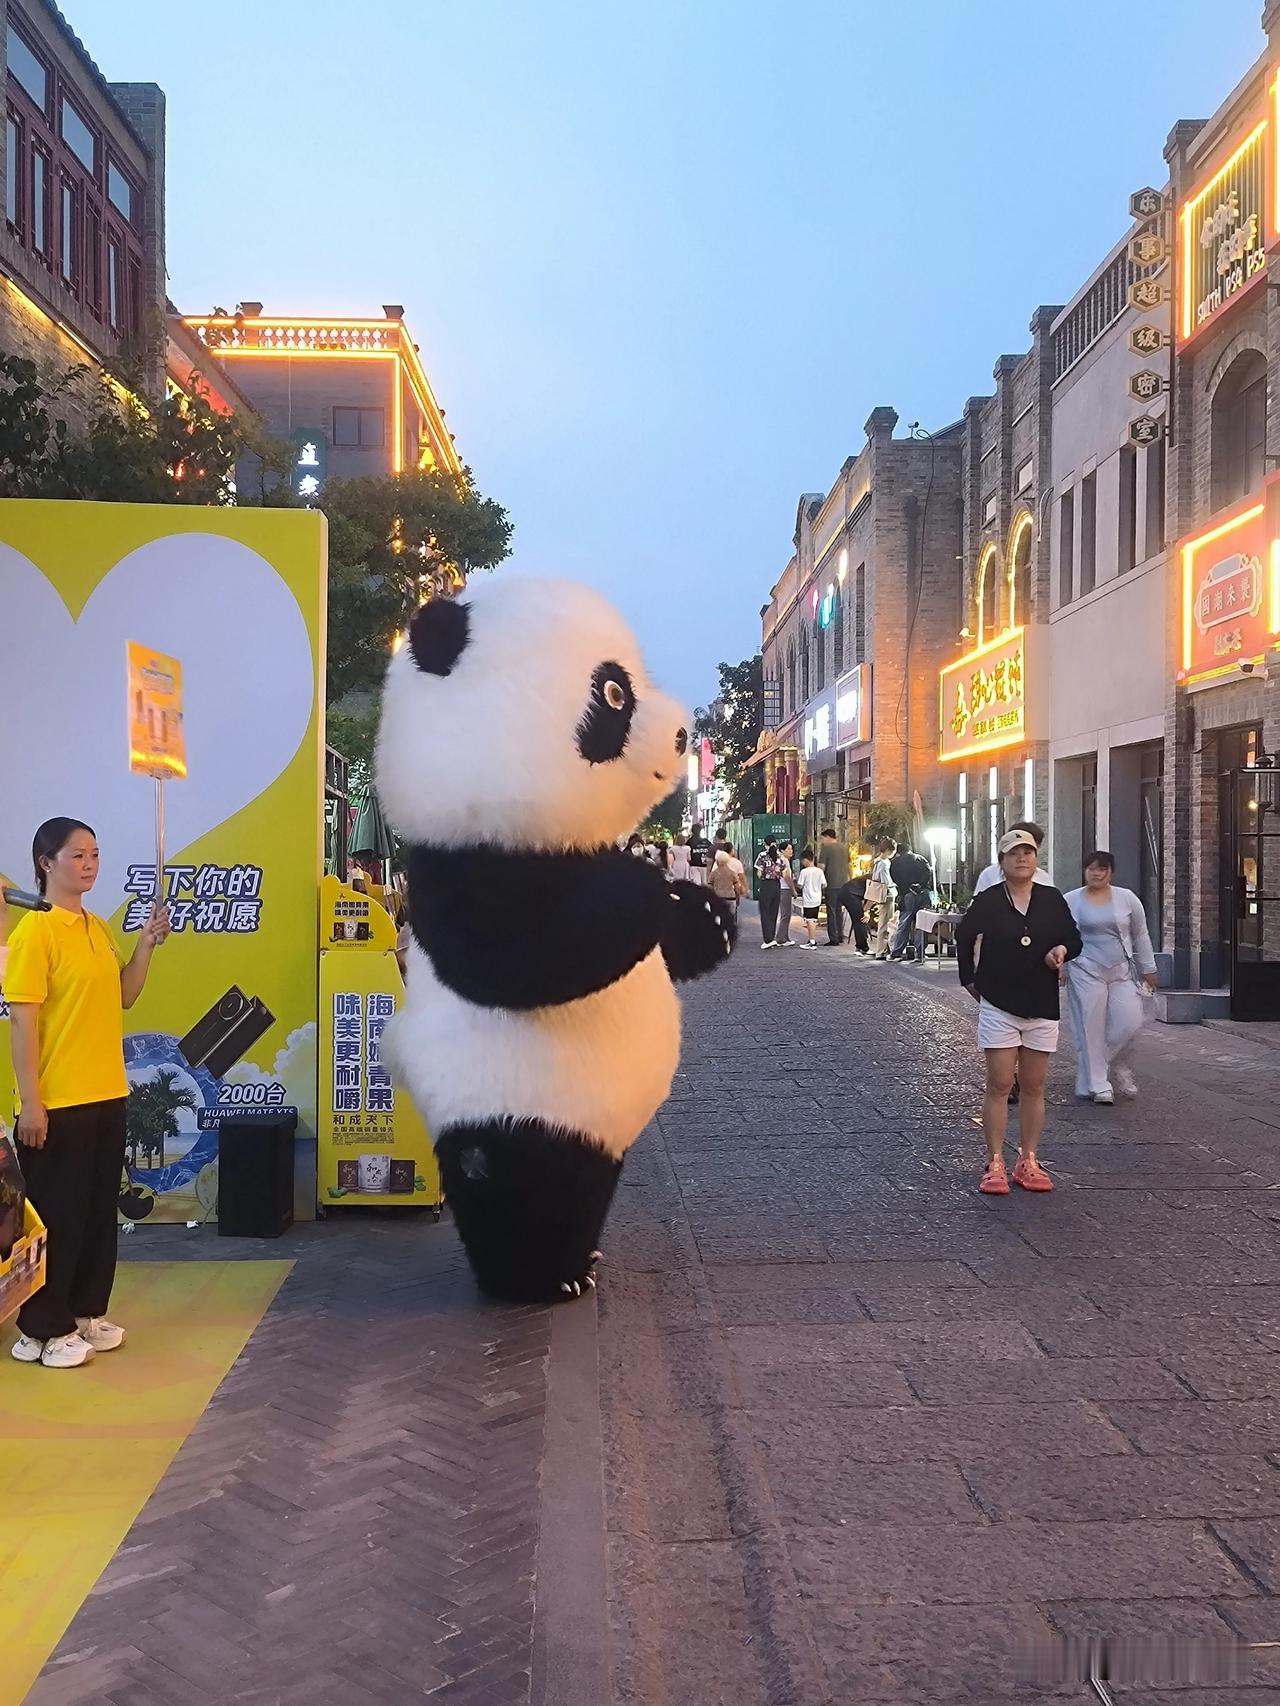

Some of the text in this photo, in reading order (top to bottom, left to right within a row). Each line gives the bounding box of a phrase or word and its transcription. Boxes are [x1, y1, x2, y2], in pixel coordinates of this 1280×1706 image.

[1247, 248, 1265, 278] PS5
[1135, 191, 1159, 442] 乐事超级密室
[125, 865, 262, 897] 写下你的
[124, 899, 262, 931] 美好祝愿
[334, 993, 362, 1111] 味美更耐嚼
[218, 1083, 285, 1104] 2000台
[204, 1109, 245, 1118] HUAWEI
[333, 1114, 394, 1125] 和成天下
